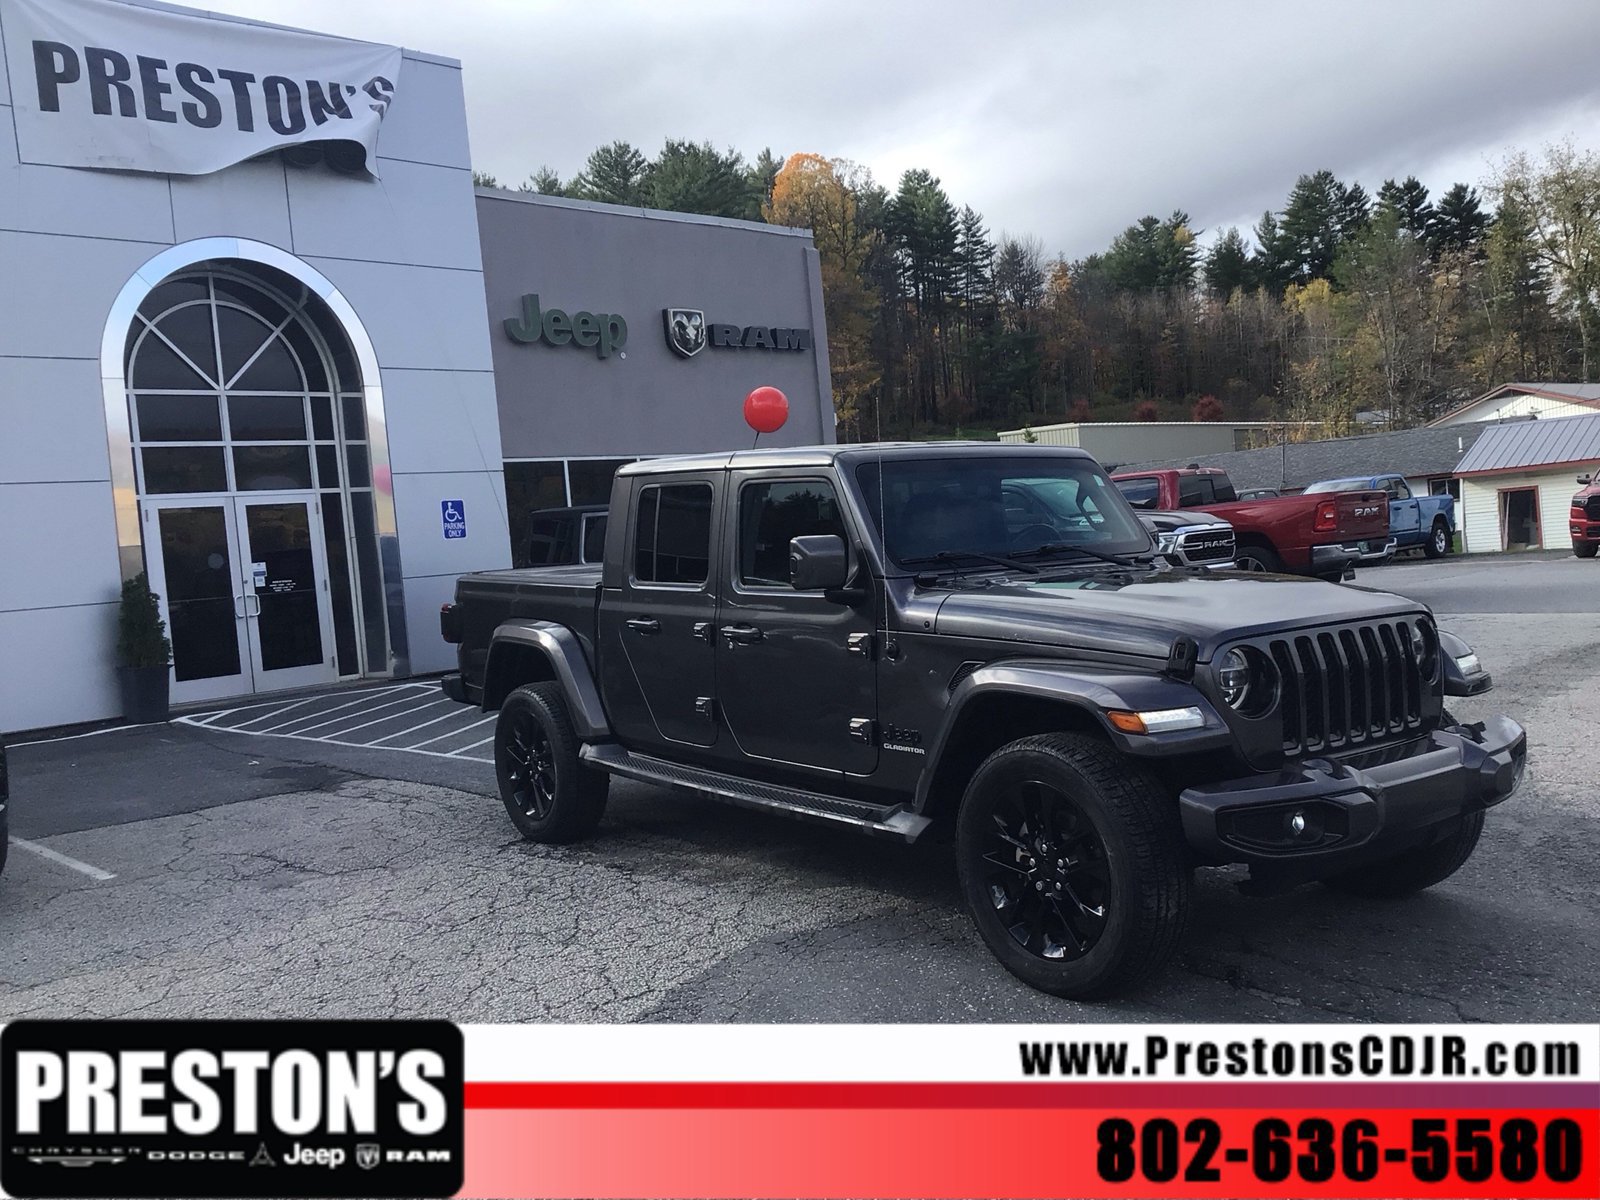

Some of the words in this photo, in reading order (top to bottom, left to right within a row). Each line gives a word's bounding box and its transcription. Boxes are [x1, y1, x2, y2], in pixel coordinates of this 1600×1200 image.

[32, 40, 394, 136] PRESTON'S
[503, 293, 628, 360] Jeep
[707, 323, 815, 351] RAM
[1354, 507, 1379, 517] RAM
[1204, 540, 1227, 549] RAM
[883, 723, 920, 743] Jeep
[883, 743, 925, 754] GLADIATOR
